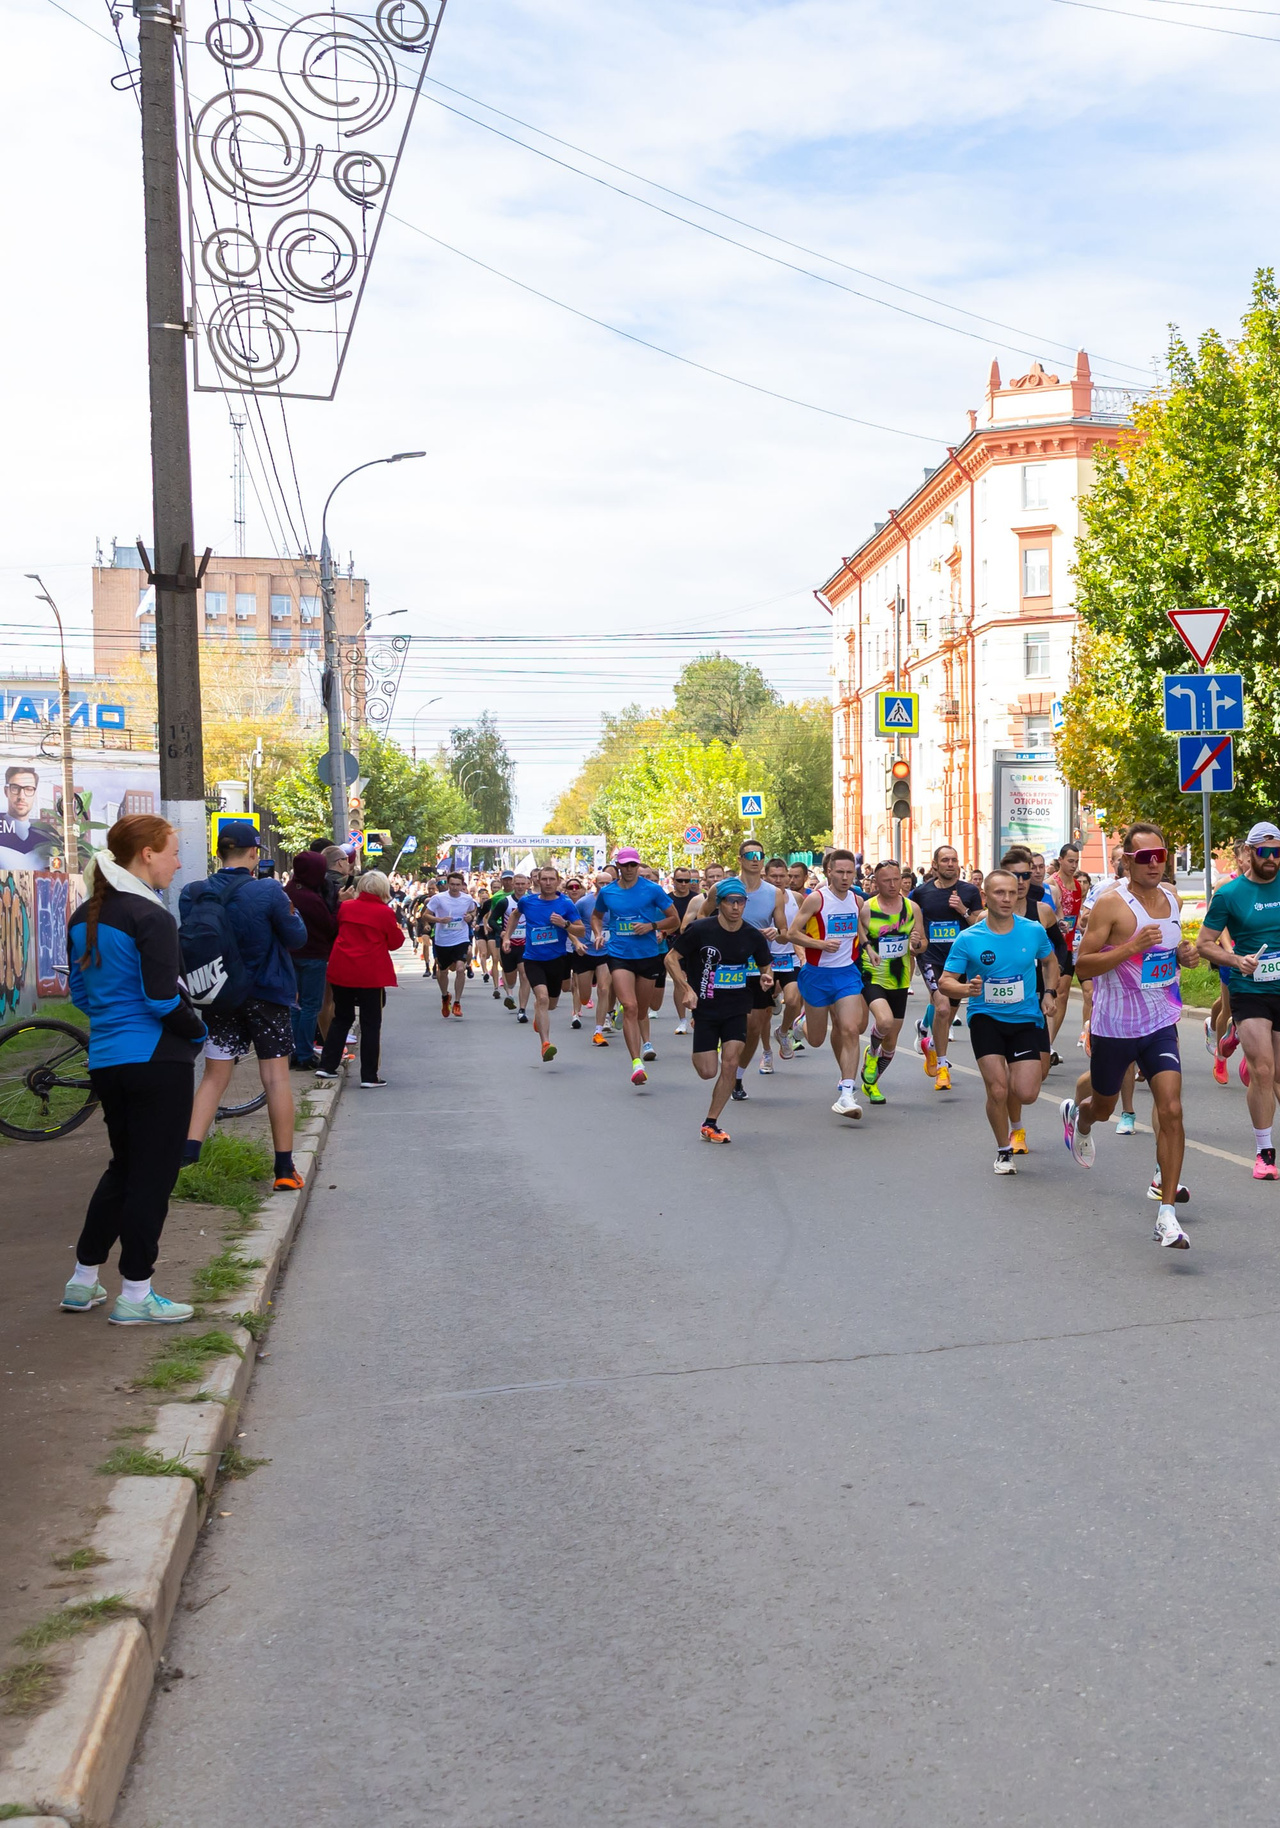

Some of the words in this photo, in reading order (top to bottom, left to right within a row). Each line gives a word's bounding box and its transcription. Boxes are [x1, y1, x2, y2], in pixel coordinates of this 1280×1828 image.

[0, 695, 125, 730] АМО
[1014, 797, 1053, 805] ОТКРЫТА
[1017, 807, 1051, 816] 576-005
[473, 836, 527, 845] ДИНАМОВСКАЯ
[530, 836, 549, 845] МИЛЯ
[834, 921, 853, 932] 534
[536, 931, 553, 940] 692
[933, 928, 956, 937] 1128
[886, 943, 903, 953] 126
[1150, 962, 1173, 979] 495
[186, 956, 226, 997] NIKE
[719, 972, 744, 983] 1245
[992, 986, 1014, 997] 285
